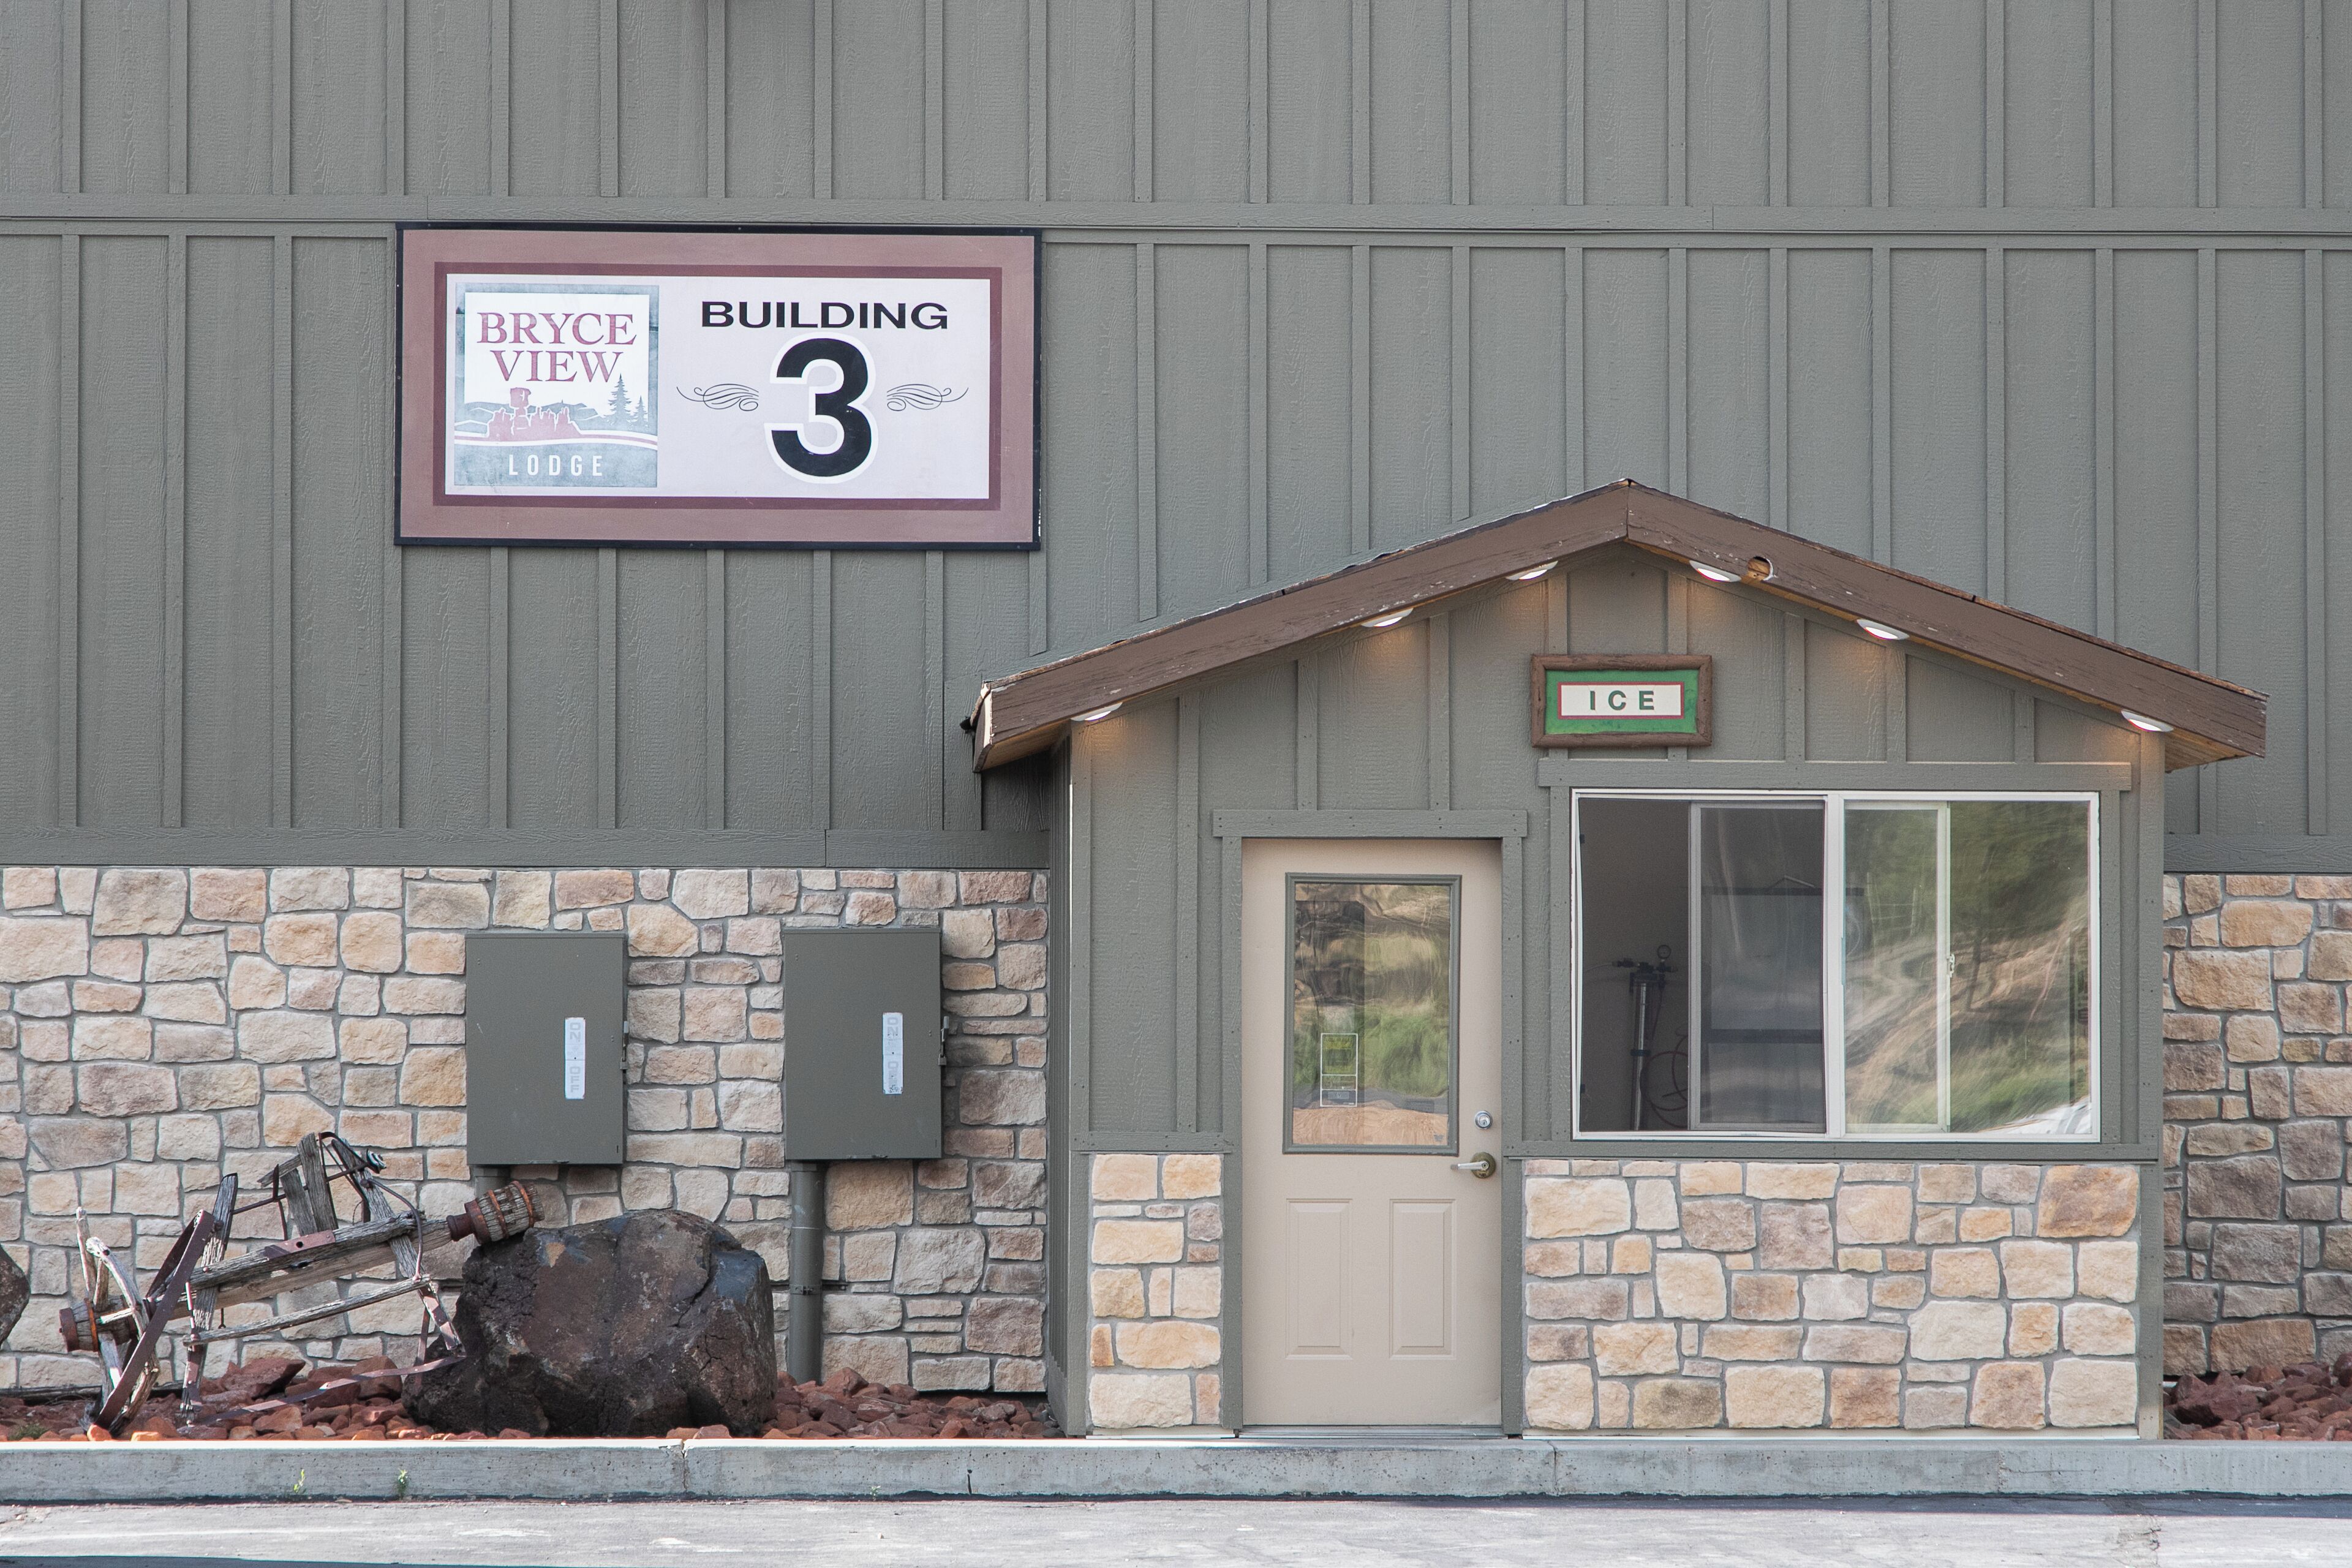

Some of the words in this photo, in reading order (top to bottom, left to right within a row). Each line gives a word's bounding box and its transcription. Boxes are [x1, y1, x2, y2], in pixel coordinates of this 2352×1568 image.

[477, 312, 637, 345] BRYCE
[702, 301, 948, 329] BUILDING
[490, 350, 624, 382] VIEW
[771, 338, 872, 477] 3
[509, 454, 603, 476] LODGE
[1590, 690, 1654, 710] ICE
[570, 1022, 581, 1042] ON
[570, 1066, 580, 1093] OFF
